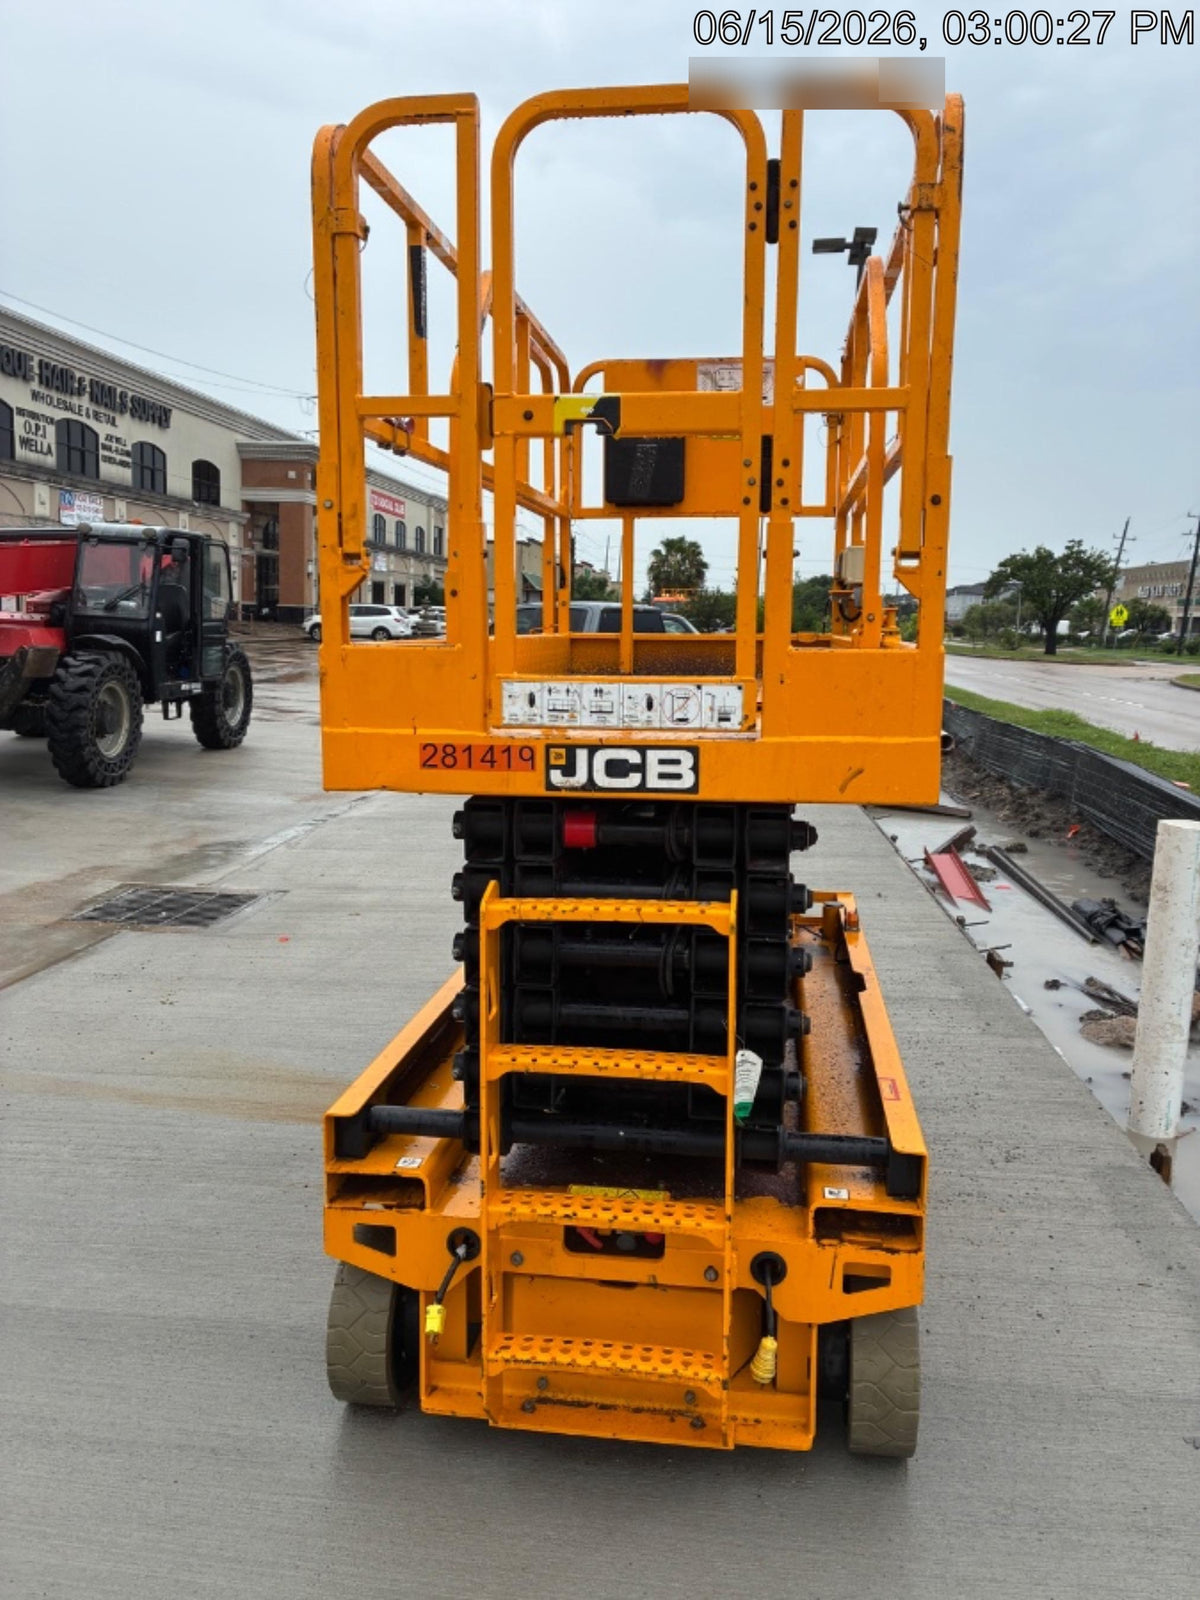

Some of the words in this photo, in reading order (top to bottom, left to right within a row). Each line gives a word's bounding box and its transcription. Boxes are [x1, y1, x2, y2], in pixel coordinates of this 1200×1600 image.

[31, 389, 83, 417] WHOLESALE
[92, 409, 118, 428] RETAIL
[39, 358, 76, 396] HAIR
[90, 378, 128, 415] NAILS
[130, 394, 173, 429] SUPPLY
[19, 435, 53, 457] WELLA
[422, 743, 535, 769] 281419
[550, 748, 696, 790] JCB
